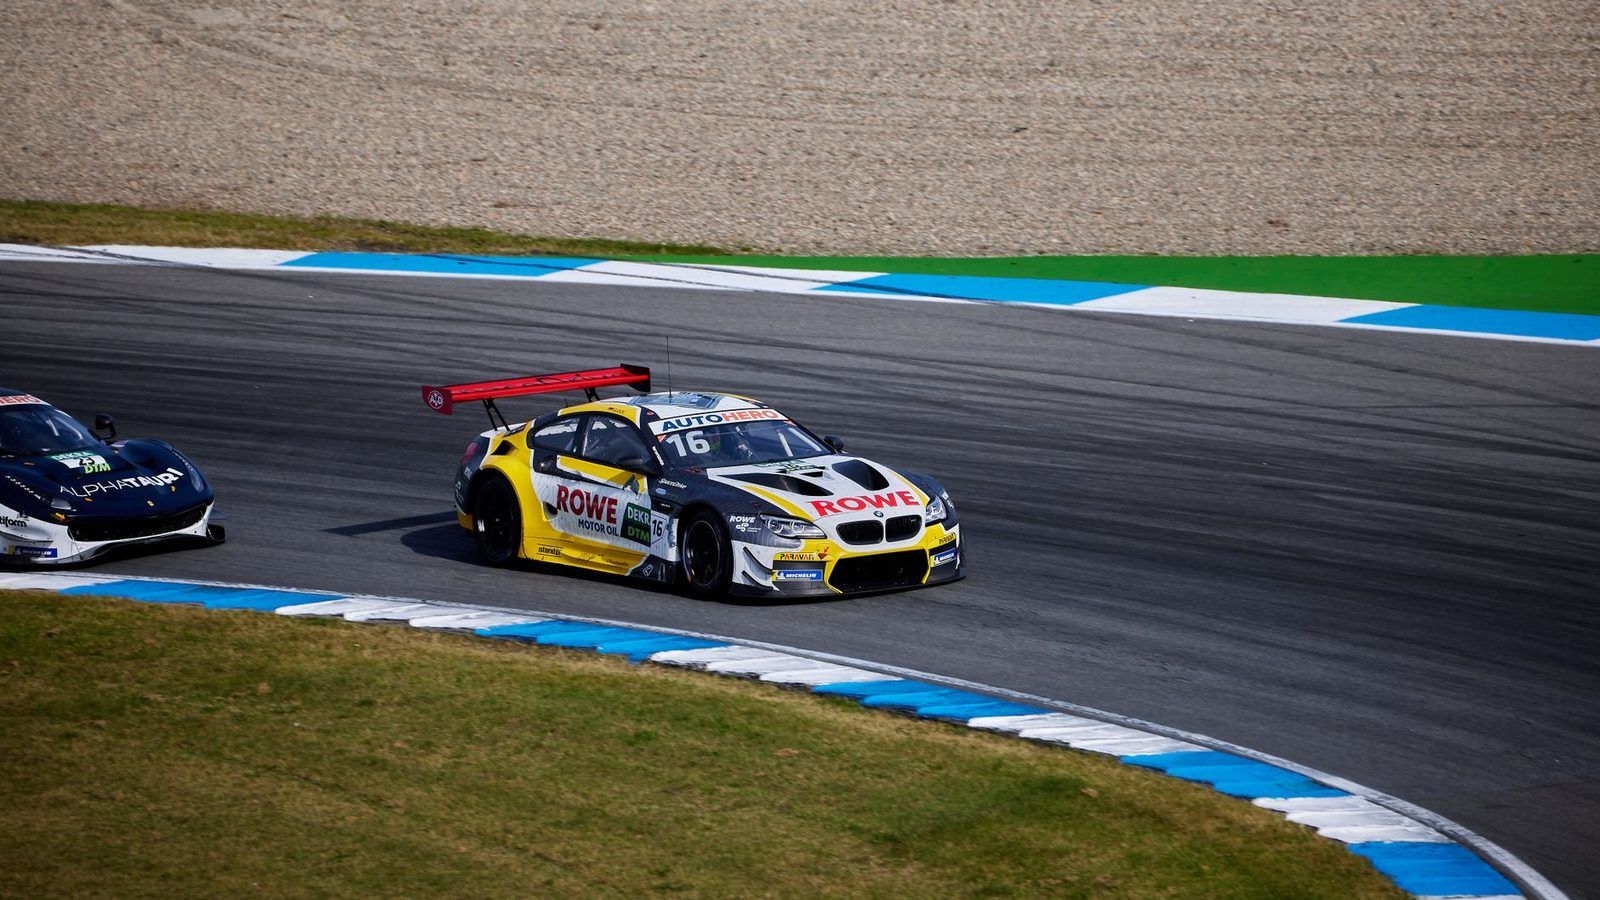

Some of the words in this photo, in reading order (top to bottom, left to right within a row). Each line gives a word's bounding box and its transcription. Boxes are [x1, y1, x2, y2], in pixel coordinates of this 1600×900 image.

[662, 411, 779, 431] AUTOHERO
[666, 431, 710, 457] 16
[84, 462, 111, 474] DTM
[60, 467, 184, 498] ALPHATAURI
[557, 484, 618, 525] ROWE
[809, 491, 919, 517] ROWE
[627, 506, 651, 526] DEKR
[729, 515, 756, 523] ROWE
[578, 518, 605, 534] MOTOR
[606, 525, 619, 536] OIL
[627, 525, 650, 543] DTM
[652, 519, 663, 537] 16
